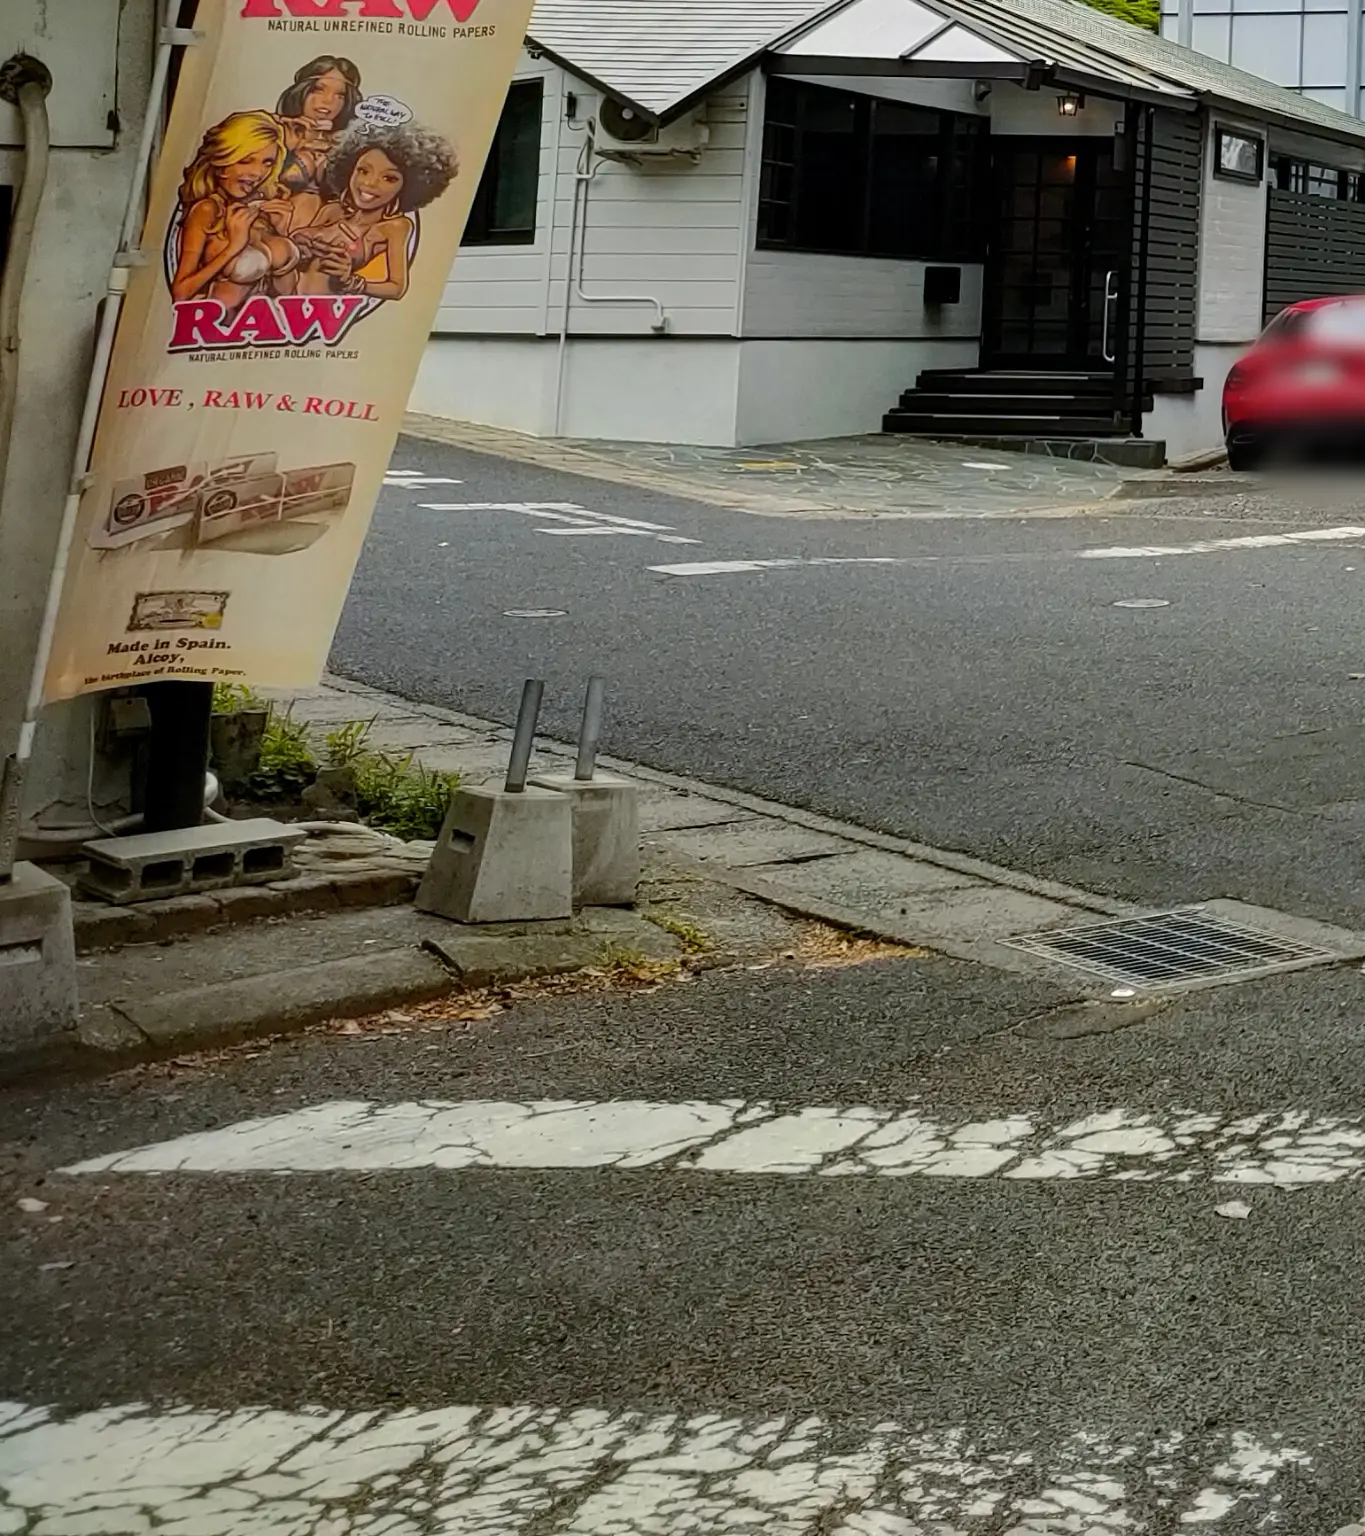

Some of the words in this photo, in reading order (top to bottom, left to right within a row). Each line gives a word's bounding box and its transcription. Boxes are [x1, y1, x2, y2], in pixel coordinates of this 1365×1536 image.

[267, 19, 320, 32] NATURAL
[324, 20, 393, 34] UNREFINED
[398, 22, 447, 38] ROLLING
[453, 25, 496, 38] PAPERS
[167, 296, 364, 349] RAW
[188, 352, 228, 362] NATURAL
[229, 350, 281, 360] UNREFINED
[284, 349, 321, 358] ROLLING
[325, 350, 359, 359] PAPERS
[202, 389, 273, 410] RAW
[276, 393, 298, 411] &
[302, 395, 380, 422] ROLL
[107, 641, 149, 655] Made
[154, 639, 170, 650] in
[176, 638, 232, 651] Spain.
[133, 653, 185, 666] Alcoy,
[154, 667, 164, 675] of
[167, 666, 207, 675] Rolling
